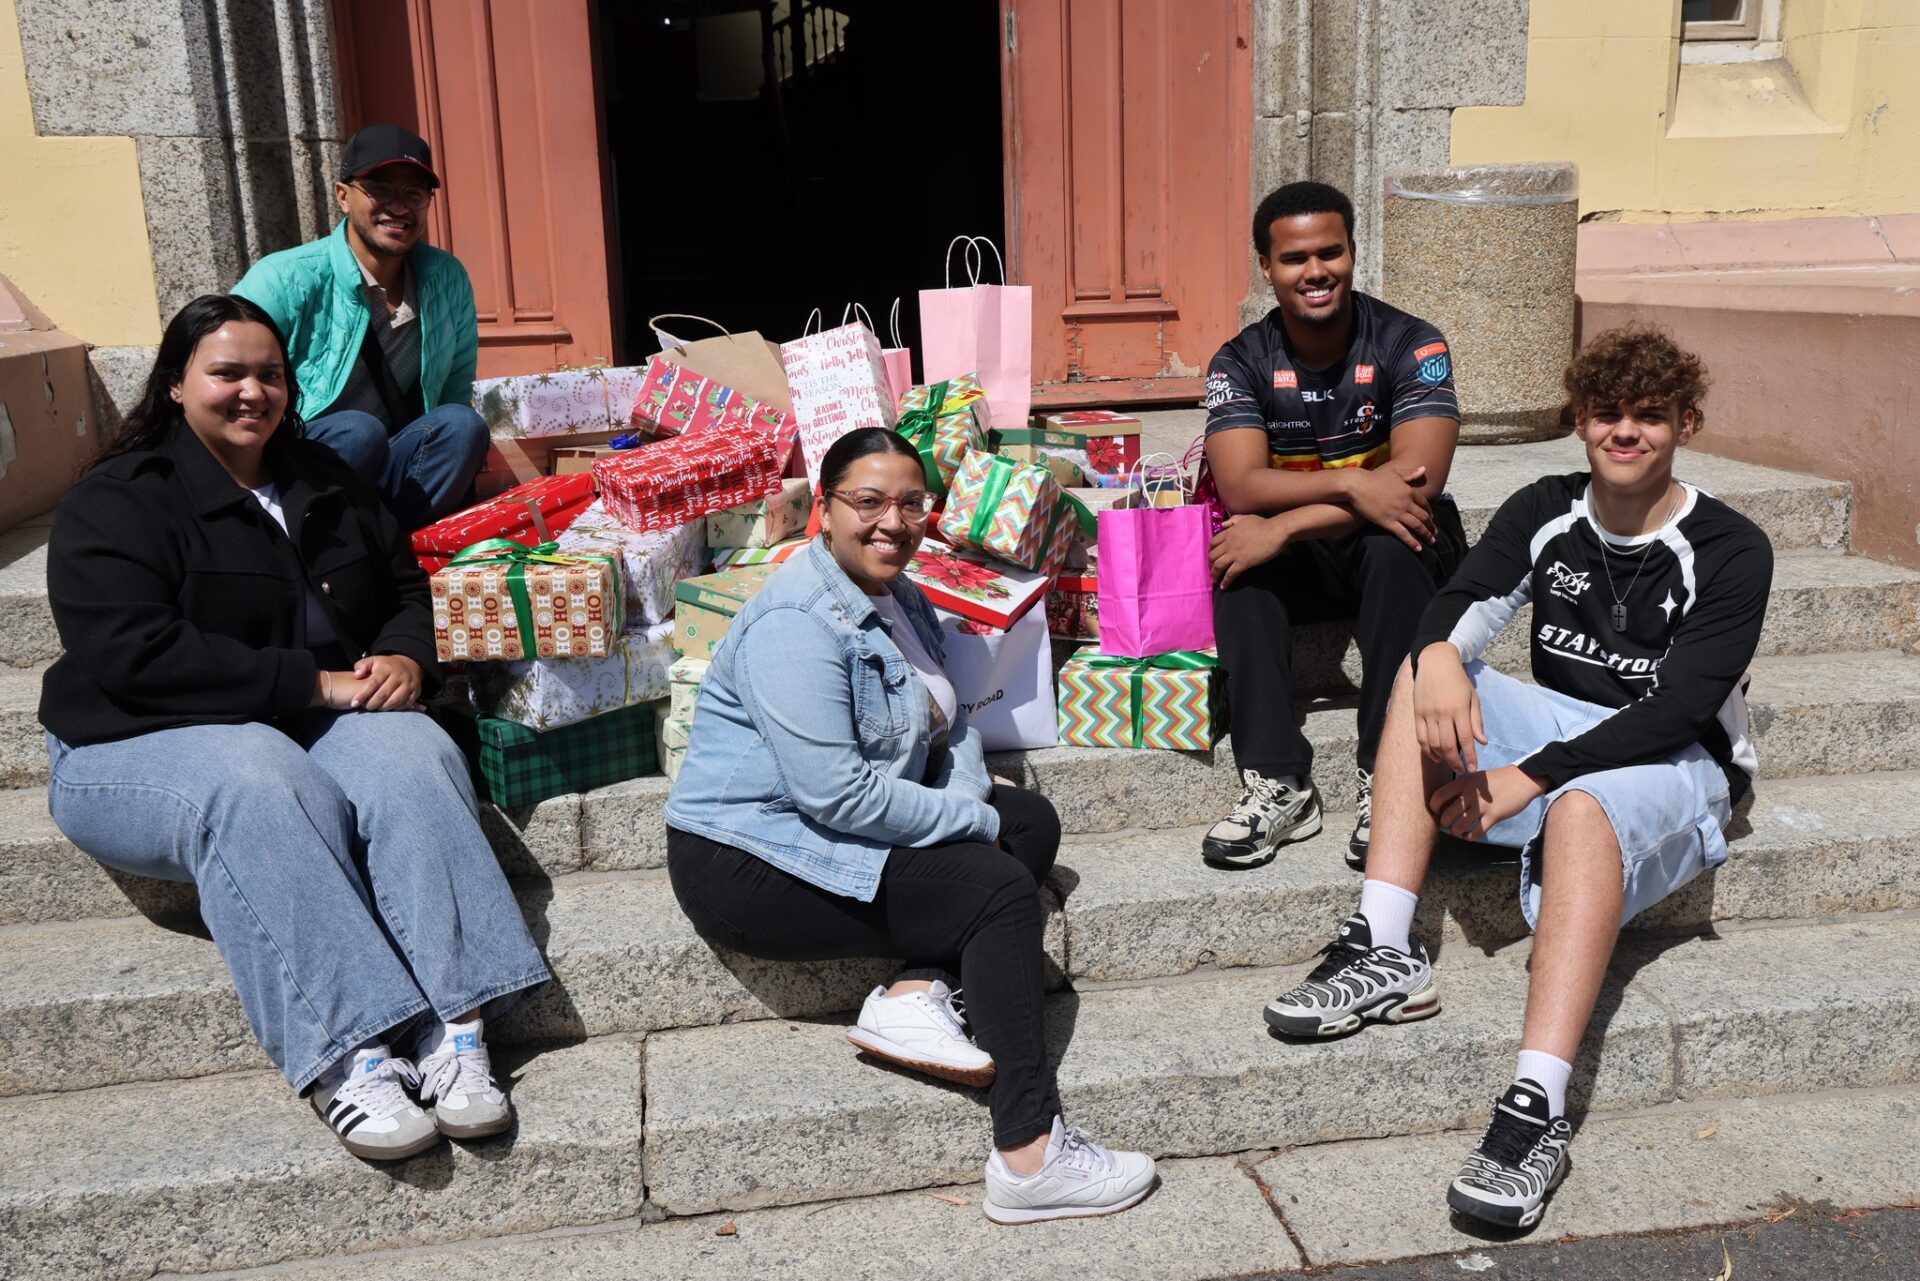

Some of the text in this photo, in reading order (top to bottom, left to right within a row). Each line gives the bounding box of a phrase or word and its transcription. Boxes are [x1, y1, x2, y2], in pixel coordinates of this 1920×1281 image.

[803, 382, 841, 399] SEASON
[820, 373, 839, 385] THE
[1301, 389, 1336, 402] BLK
[813, 410, 847, 428] GREETINGS
[449, 597, 464, 625] HO
[484, 597, 498, 625] HO
[553, 596, 567, 623] HO
[587, 595, 602, 623] HO
[452, 628, 468, 657] HO
[487, 628, 502, 656] HO
[555, 626, 571, 655] HO
[589, 625, 605, 654] HO
[976, 689, 1004, 711] ROAD
